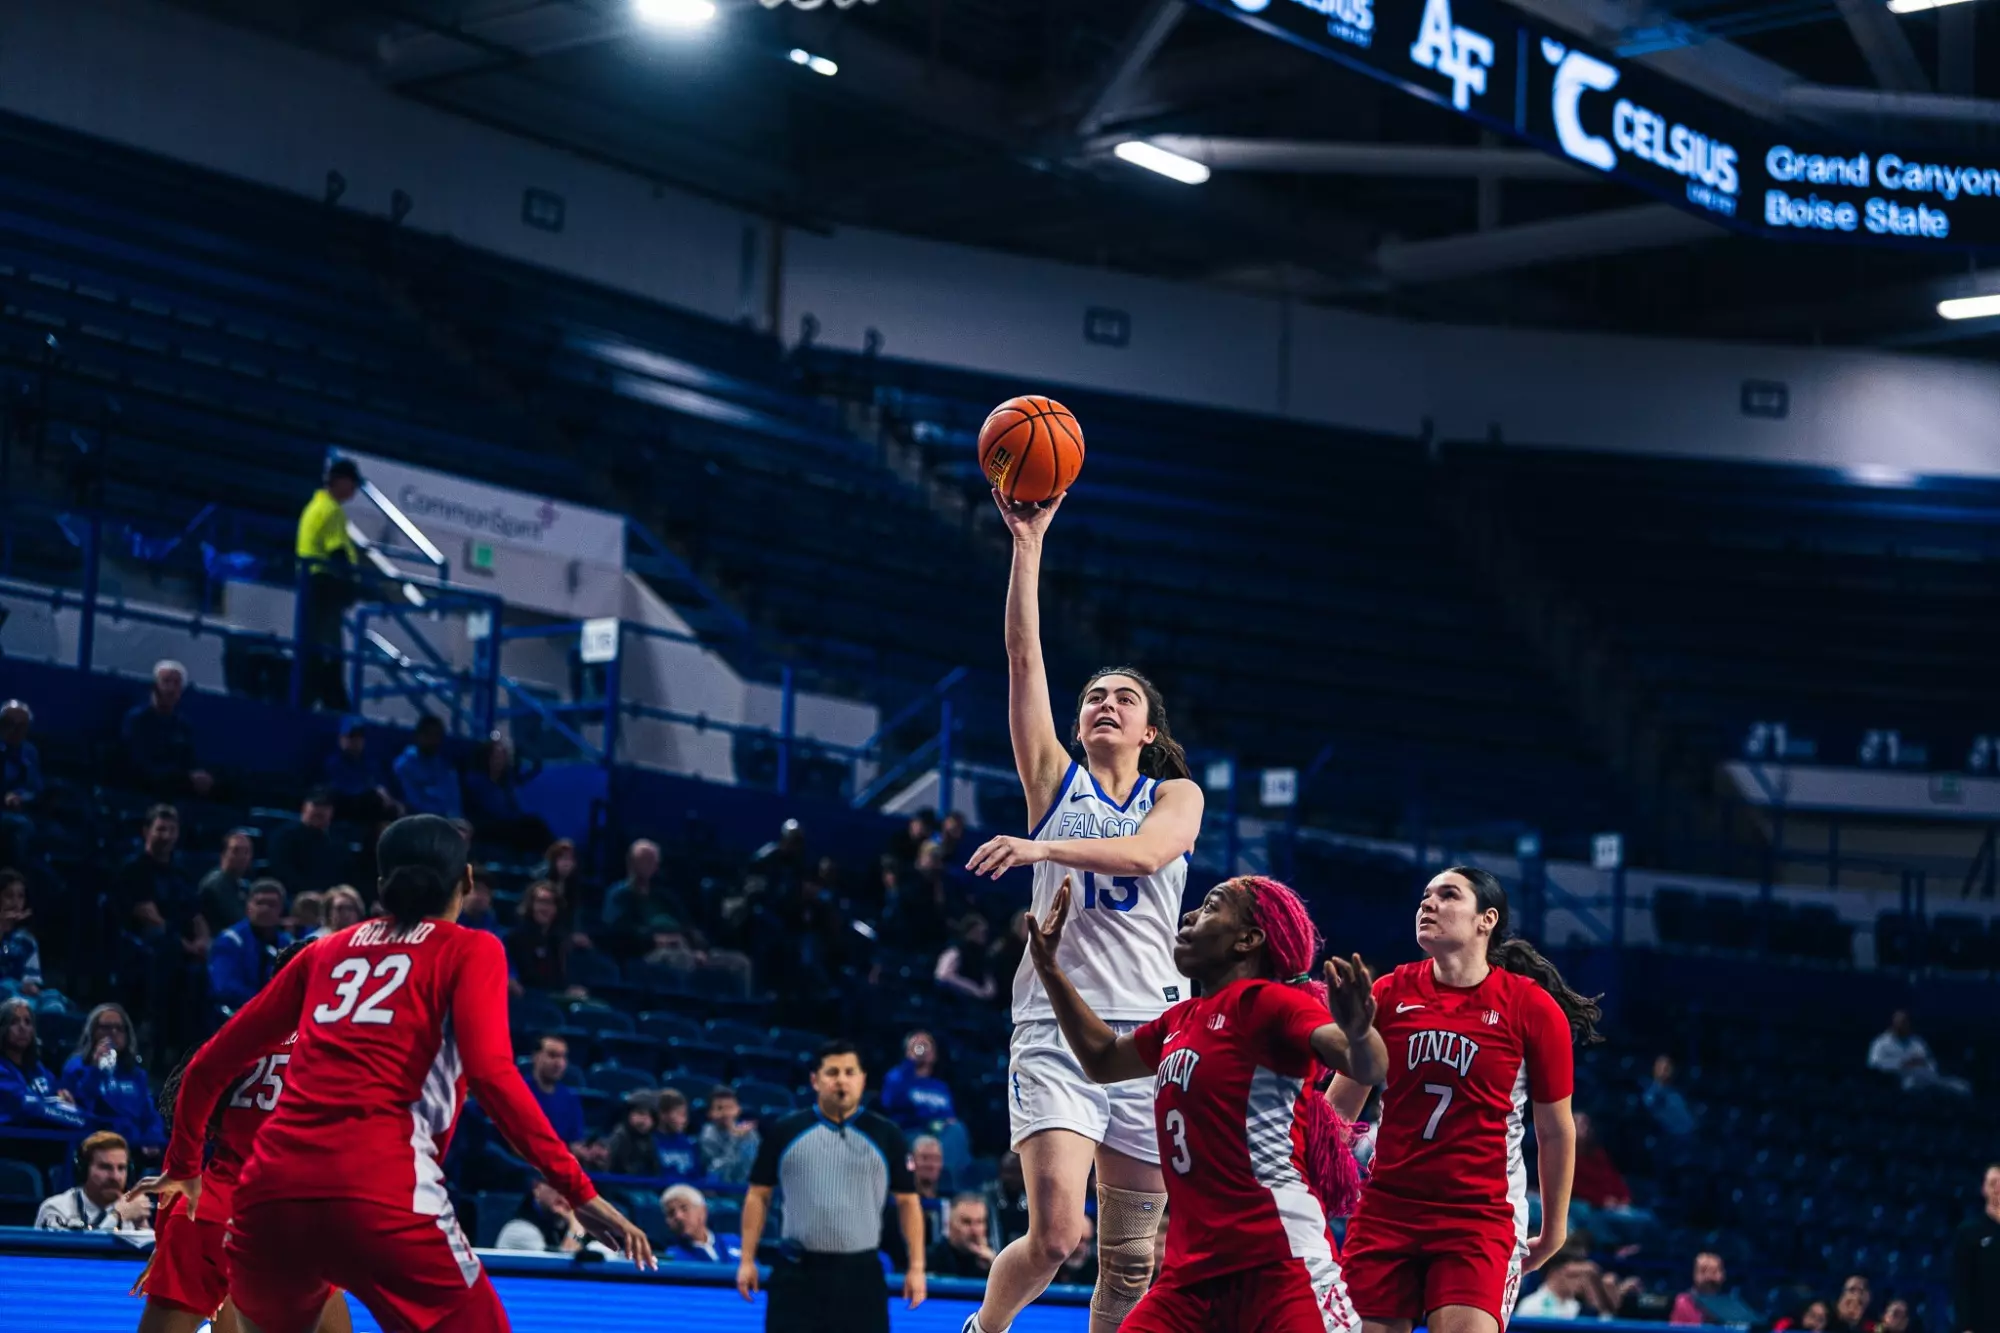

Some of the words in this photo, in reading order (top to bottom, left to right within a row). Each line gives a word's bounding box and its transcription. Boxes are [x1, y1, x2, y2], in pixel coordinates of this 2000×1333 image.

[1410, 0, 1494, 112] AF
[1612, 97, 1740, 195] CELSIUS
[1765, 144, 1870, 188] Grand
[1876, 152, 2000, 201] Canyon
[1765, 189, 1858, 232] Boise
[1863, 196, 1950, 239] State
[1083, 870, 1139, 912] 13
[313, 953, 412, 1025] 32
[229, 1053, 291, 1112] 25
[1153, 1047, 1201, 1101] UNLV
[1406, 1029, 1479, 1077] UNLV
[1422, 1082, 1453, 1141] 7
[1165, 1108, 1192, 1175] 3
